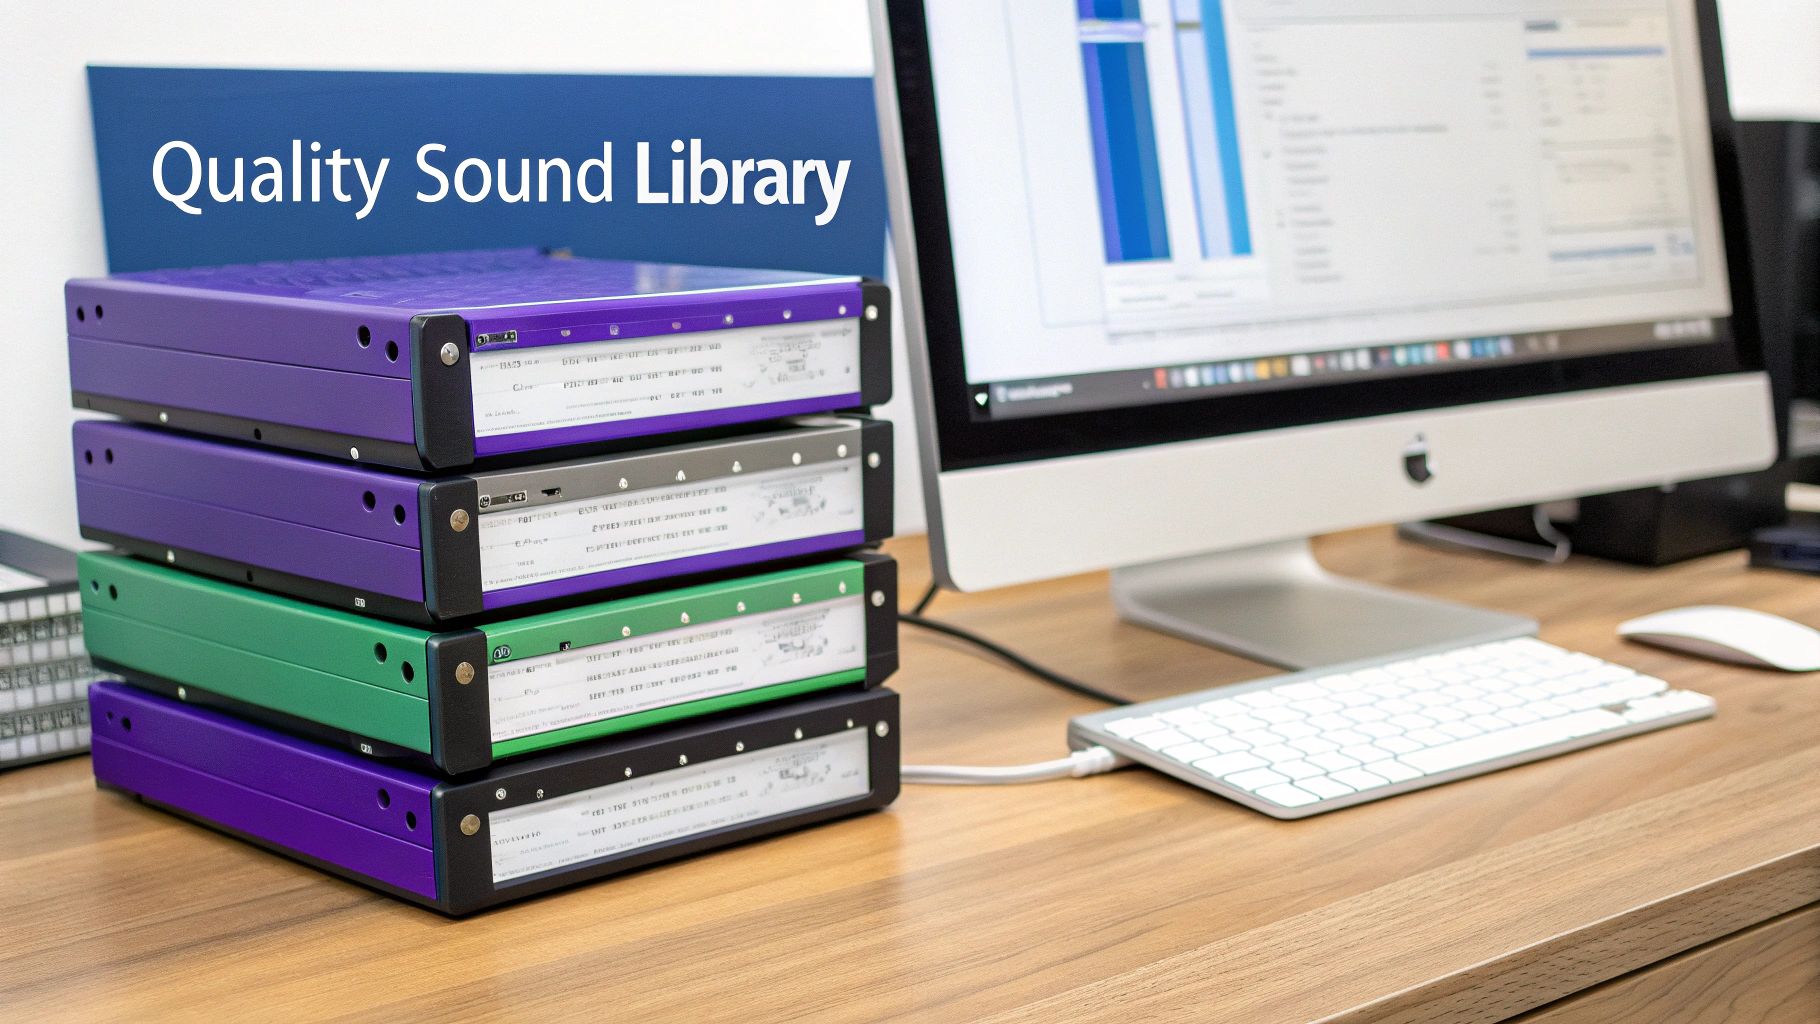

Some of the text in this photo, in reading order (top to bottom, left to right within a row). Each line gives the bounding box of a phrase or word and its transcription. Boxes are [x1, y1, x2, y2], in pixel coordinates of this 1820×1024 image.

[152, 138, 852, 226] Quality Sound Library
